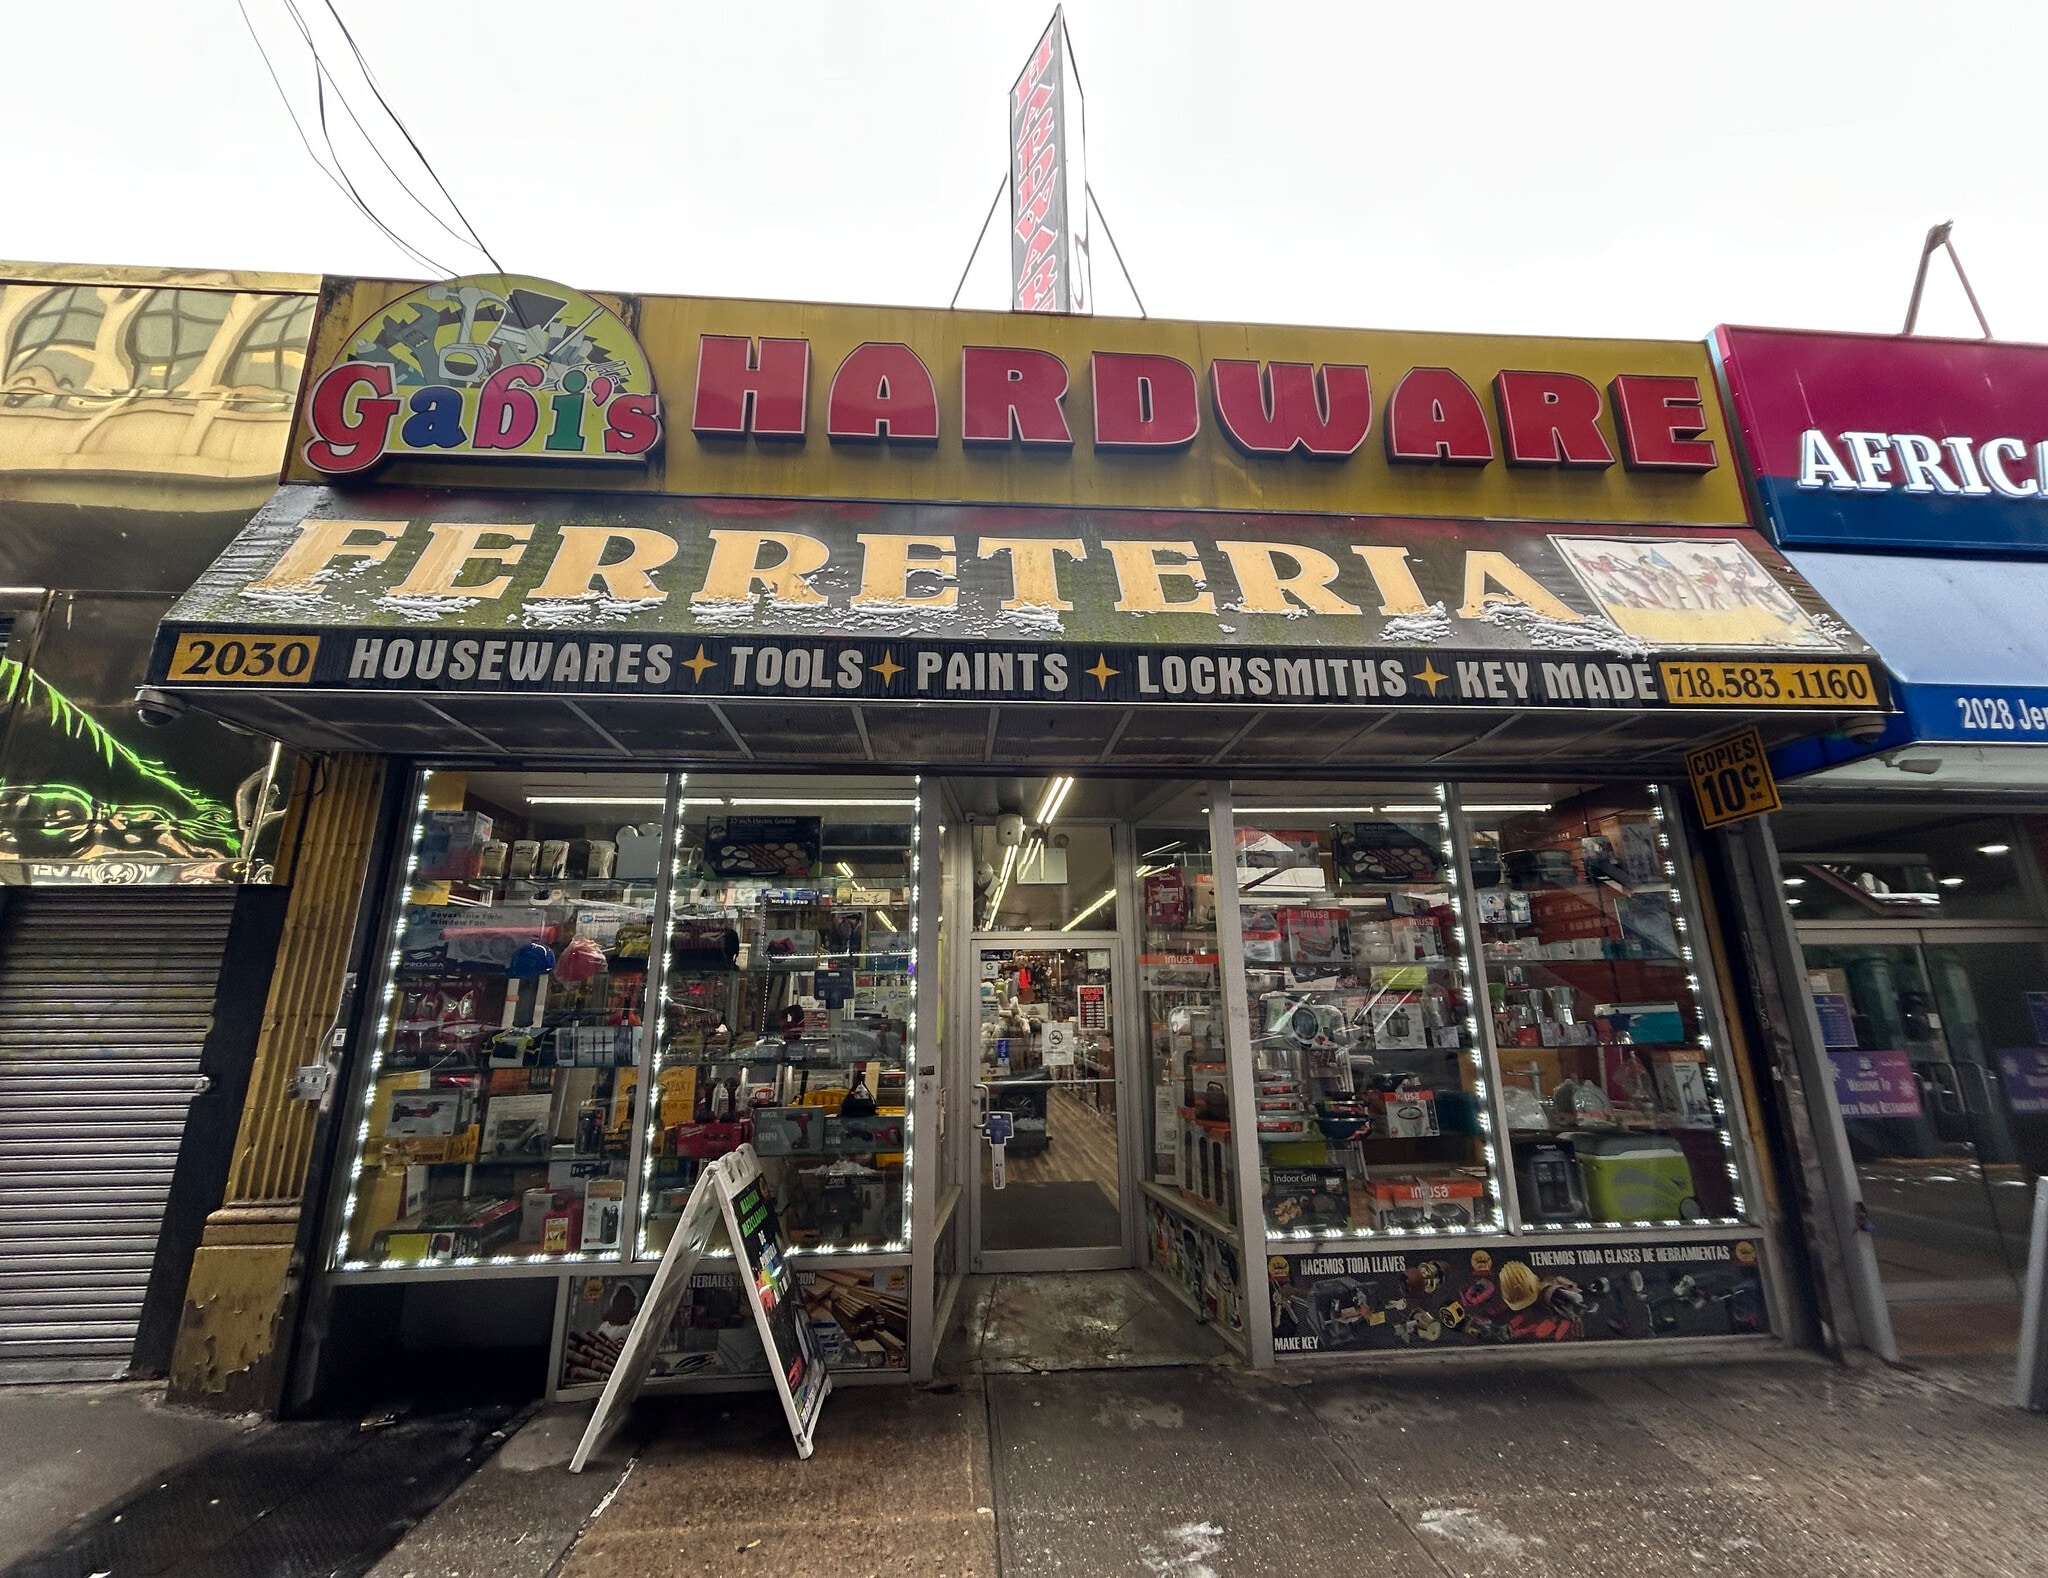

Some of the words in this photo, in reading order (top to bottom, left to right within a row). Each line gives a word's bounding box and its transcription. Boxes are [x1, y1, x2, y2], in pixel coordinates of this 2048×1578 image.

[306, 361, 660, 473] Gabi's
[691, 334, 1718, 473] HARDWARE
[246, 519, 1586, 621] FERRETERIA
[182, 640, 311, 676] 2030
[347, 638, 673, 682] HOUSEWARES
[730, 646, 863, 689] TOOLS
[917, 651, 1069, 691] PAINTS
[1137, 654, 1407, 698] LOCKSMITHS
[1456, 661, 1528, 699] KEY
[1542, 662, 1658, 700] MADE
[1670, 666, 1868, 700] 718.583.1160
[1957, 697, 2015, 730] 2028
[1693, 738, 1756, 776] COPIES
[1300, 909, 1330, 919] imusa
[1409, 917, 1435, 926] imusa
[1165, 955, 1194, 964] imusa
[1273, 1174, 1299, 1183] Indoor
[1300, 1173, 1317, 1183] Grill
[1300, 1257, 1345, 1276] HACEMOS
[1346, 1256, 1371, 1275] TODA
[1372, 1255, 1406, 1273] LLAVES
[1529, 1250, 1576, 1266] TENEMOS
[1577, 1249, 1604, 1265] TODA
[1605, 1248, 1642, 1265] CLASES
[1642, 1247, 1656, 1262] DE
[1656, 1245, 1731, 1263] HERRAMIENTAS
[687, 1273, 734, 1289] TERIALES
[1274, 1336, 1300, 1351] MAKE
[1301, 1335, 1319, 1350] KEY
